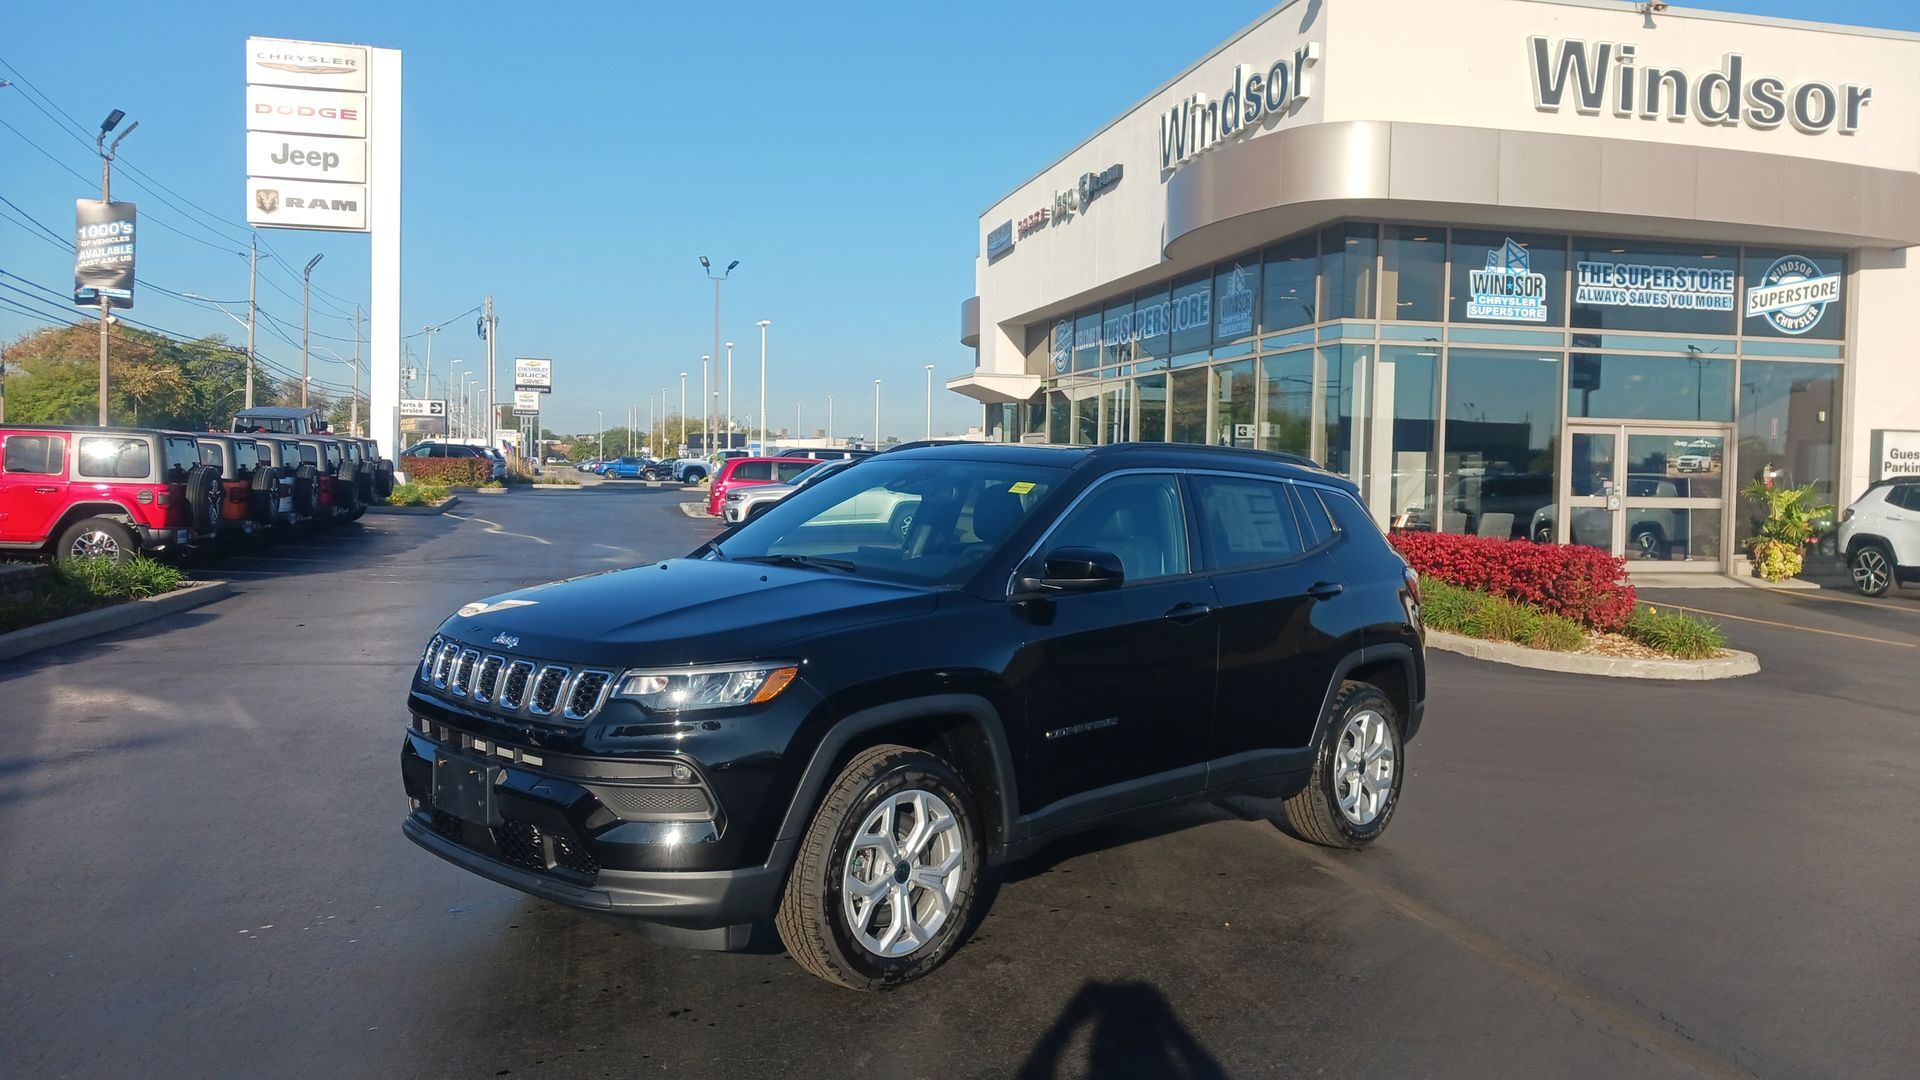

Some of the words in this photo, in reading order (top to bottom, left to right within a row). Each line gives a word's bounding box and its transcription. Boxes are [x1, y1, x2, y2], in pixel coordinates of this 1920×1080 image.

[256, 52, 356, 66] CHRYSLER
[1526, 34, 1872, 136] Windsor
[255, 103, 357, 121] DODGE
[1159, 41, 1320, 171] Windsor
[270, 143, 340, 171] Jeep
[285, 197, 357, 212] RAM
[78, 221, 133, 239] 1000's
[93, 235, 130, 245] VEHICLES
[79, 244, 133, 260] AVAILABLE
[79, 258, 100, 267] JUST
[101, 256, 118, 265] ASK
[120, 254, 132, 262] US
[1578, 263, 1613, 284] THE
[1615, 264, 1734, 291] SUPERSTORE
[1769, 261, 1812, 282] WINDSOR
[1472, 273, 1543, 297] WINDSOR
[1478, 296, 1537, 306] CHRYSLER
[1578, 289, 1626, 303] ALWAYS
[1629, 290, 1668, 306] SAVES
[1670, 293, 1693, 306] YOU
[1695, 295, 1733, 309] MORE!
[1751, 281, 1837, 309] SUPERSTORE
[1104, 318, 1119, 346] THE
[1119, 291, 1210, 344] SUPERSTORE
[1470, 305, 1545, 318] SUPERSTORE
[1775, 306, 1819, 329] CHRYSLER
[1890, 448, 1920, 460] Gues
[1884, 461, 1920, 473] Parkin
[491, 631, 520, 649] Jeep
